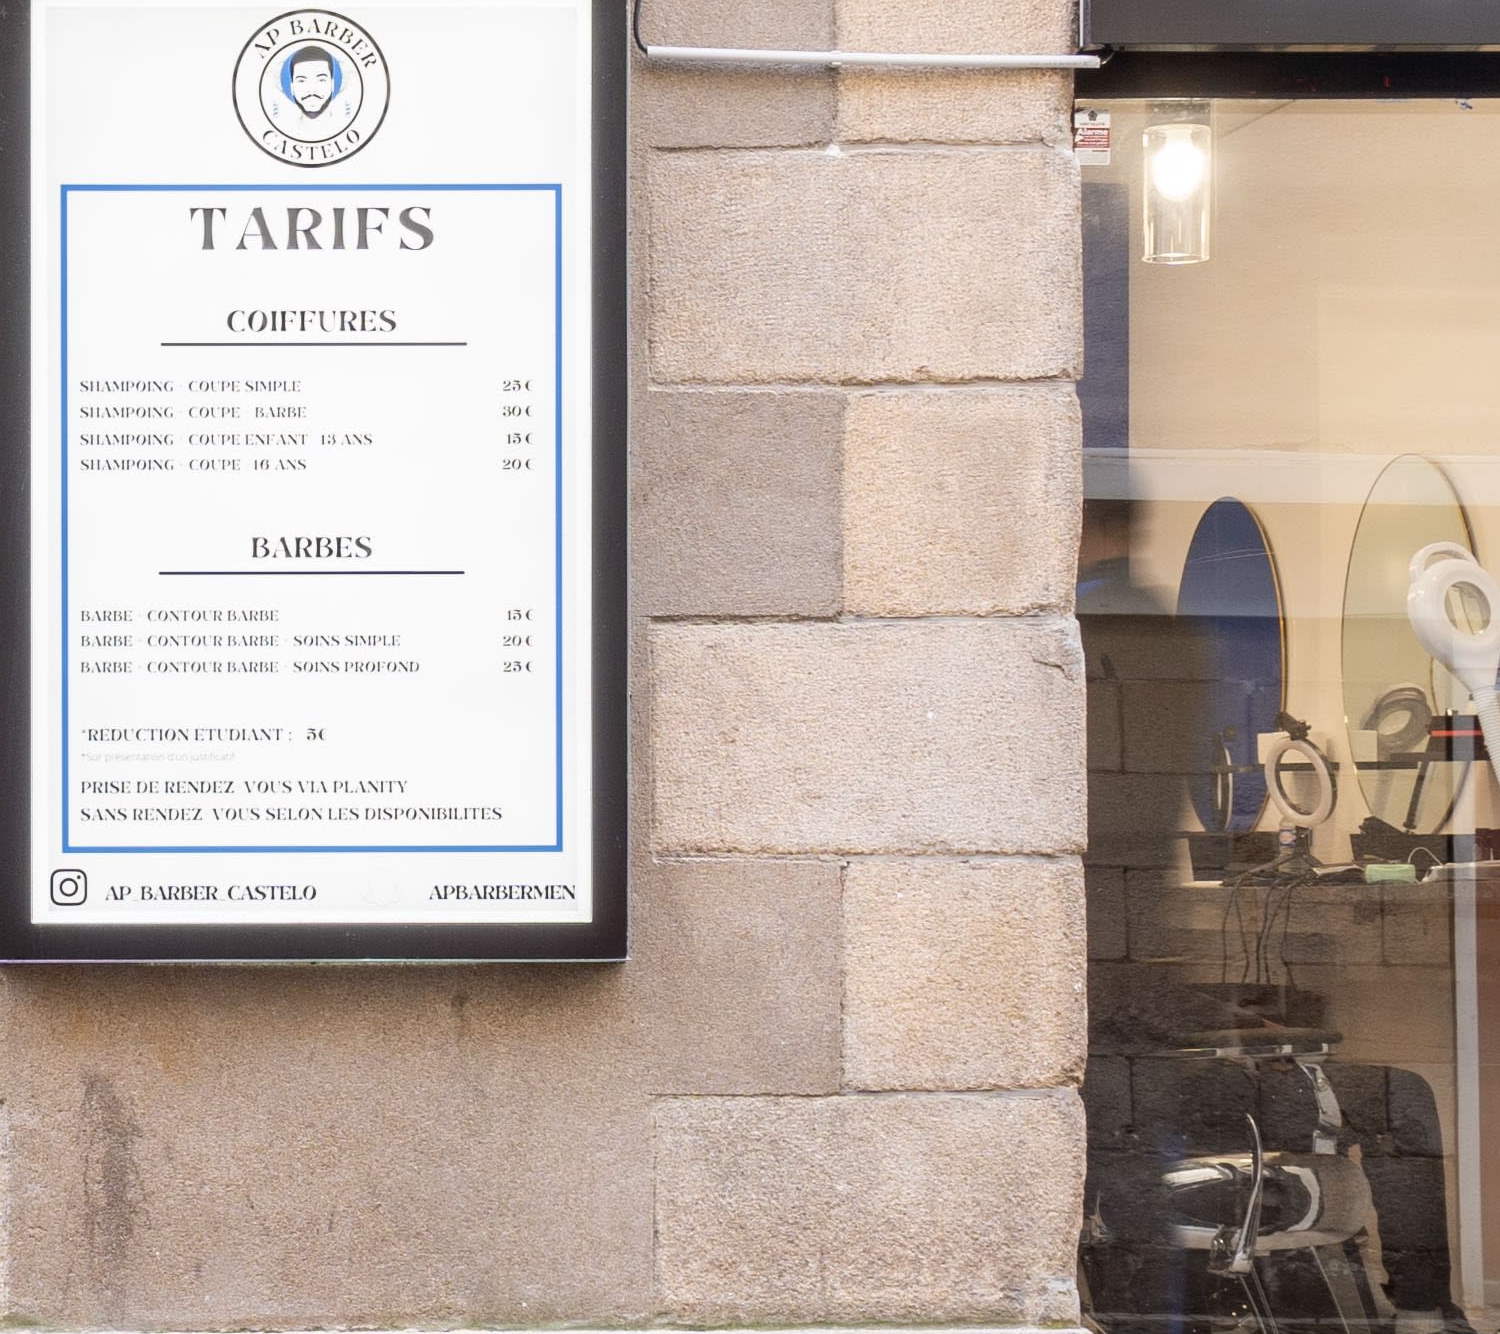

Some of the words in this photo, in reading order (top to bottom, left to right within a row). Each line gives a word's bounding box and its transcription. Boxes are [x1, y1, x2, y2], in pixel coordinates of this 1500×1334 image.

[254, 28, 280, 59] AP
[290, 19, 377, 68] BARBER
[262, 129, 360, 161] CASTELO
[189, 206, 435, 251] TARIFS
[226, 309, 397, 333] COIFFURES
[79, 380, 174, 393] SHAMPOING
[188, 380, 241, 393] COUPE
[244, 380, 302, 393] SIMPLE
[502, 379, 522, 392] 25
[79, 406, 174, 419] SHAMPOING
[188, 406, 241, 419] COUPE
[255, 406, 307, 419] BARBE
[502, 404, 522, 418] 30
[79, 433, 174, 446] SHAMPOING
[188, 433, 241, 446] COUPE
[244, 433, 309, 446] ENFANT
[340, 433, 373, 446] ANS
[507, 432, 522, 445] 15
[80, 458, 175, 471] SHAMPOING
[188, 458, 241, 471] COUPE
[274, 458, 307, 471] ANS
[501, 458, 522, 471] 20
[251, 536, 373, 559] BARBES
[80, 610, 133, 623] BARBE
[146, 609, 223, 622] CONTOUR
[227, 609, 279, 622] BARBE
[80, 635, 133, 648] BARBE
[147, 634, 223, 648] CONTOUR
[227, 634, 279, 648] BARBE
[293, 634, 341, 647] SOINS
[344, 634, 401, 647] SIMPLE
[80, 661, 133, 674] BARBE
[146, 661, 223, 674] CONTOUR
[227, 661, 279, 674] BARBE
[292, 660, 341, 673] SOINS
[344, 660, 420, 673] PROFOND
[80, 780, 132, 795] PRISE
[136, 780, 160, 794] DE
[297, 780, 328, 794] VIA
[332, 780, 409, 794] PLANITY
[80, 807, 128, 822] SANS
[265, 807, 323, 821] SELON
[328, 807, 360, 821] LES
[364, 806, 503, 821] DISPONIBILITES
[428, 884, 577, 901] APBARBERMEN
